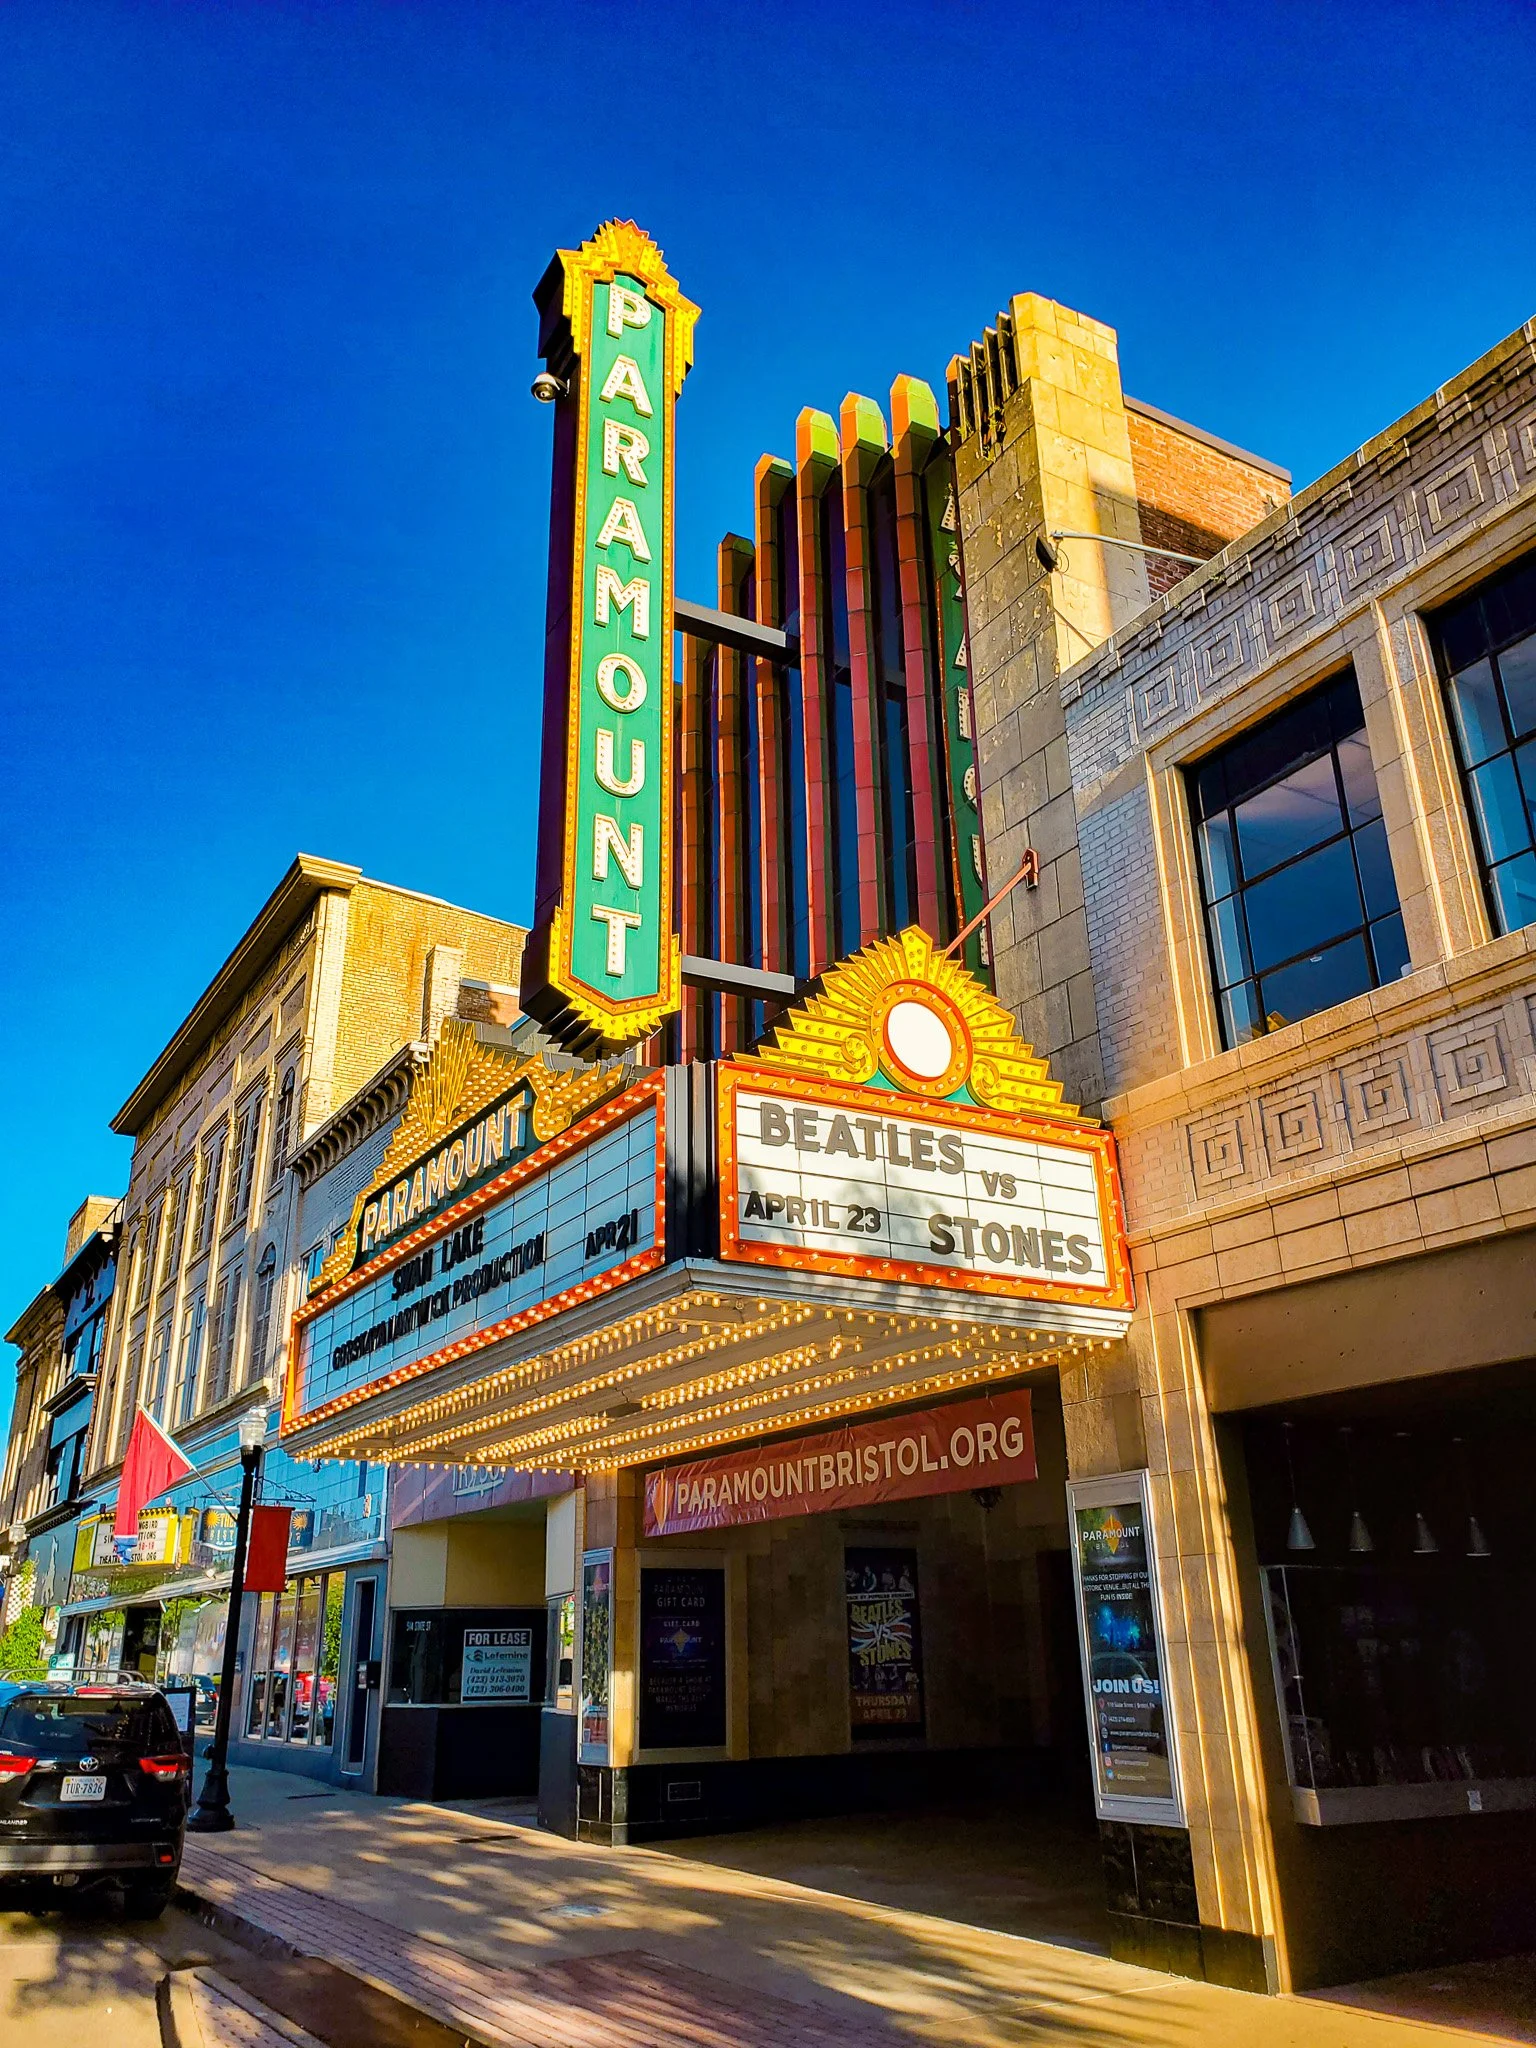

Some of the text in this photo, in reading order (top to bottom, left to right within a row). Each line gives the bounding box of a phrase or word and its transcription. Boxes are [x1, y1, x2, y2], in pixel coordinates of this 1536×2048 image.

[590, 281, 655, 979] PARAMOUNT
[759, 1101, 964, 1175] BEATLES
[361, 1090, 532, 1252] PARAMOUNT
[980, 1170, 1017, 1200] VS
[743, 1190, 881, 1233] APRIL 23
[928, 1213, 1093, 1275] STONES
[391, 1216, 485, 1301] SWAN LAKE
[453, 1231, 547, 1310] PRODUCTION
[676, 1416, 1025, 1514] PARAMOUNTBRISTOL.ORG
[1082, 1526, 1140, 1541] PARAMOUNT
[1083, 1574, 1098, 1582] HANKS
[1139, 1571, 1148, 1579] OU
[657, 1596, 706, 1608] GIFT CARD
[851, 1599, 904, 1624] BEATLES
[468, 1632, 528, 1645] FOR LEASE
[873, 1623, 891, 1641] VS
[484, 1651, 529, 1660] Lefemine
[858, 1639, 912, 1667] STONES
[466, 1675, 488, 1685] (423)
[466, 1685, 488, 1696] (423)
[1092, 1679, 1161, 1695] JOIN US!
[855, 1695, 913, 1706] THURSDAY
[65, 1782, 103, 1795] TUR-7826
